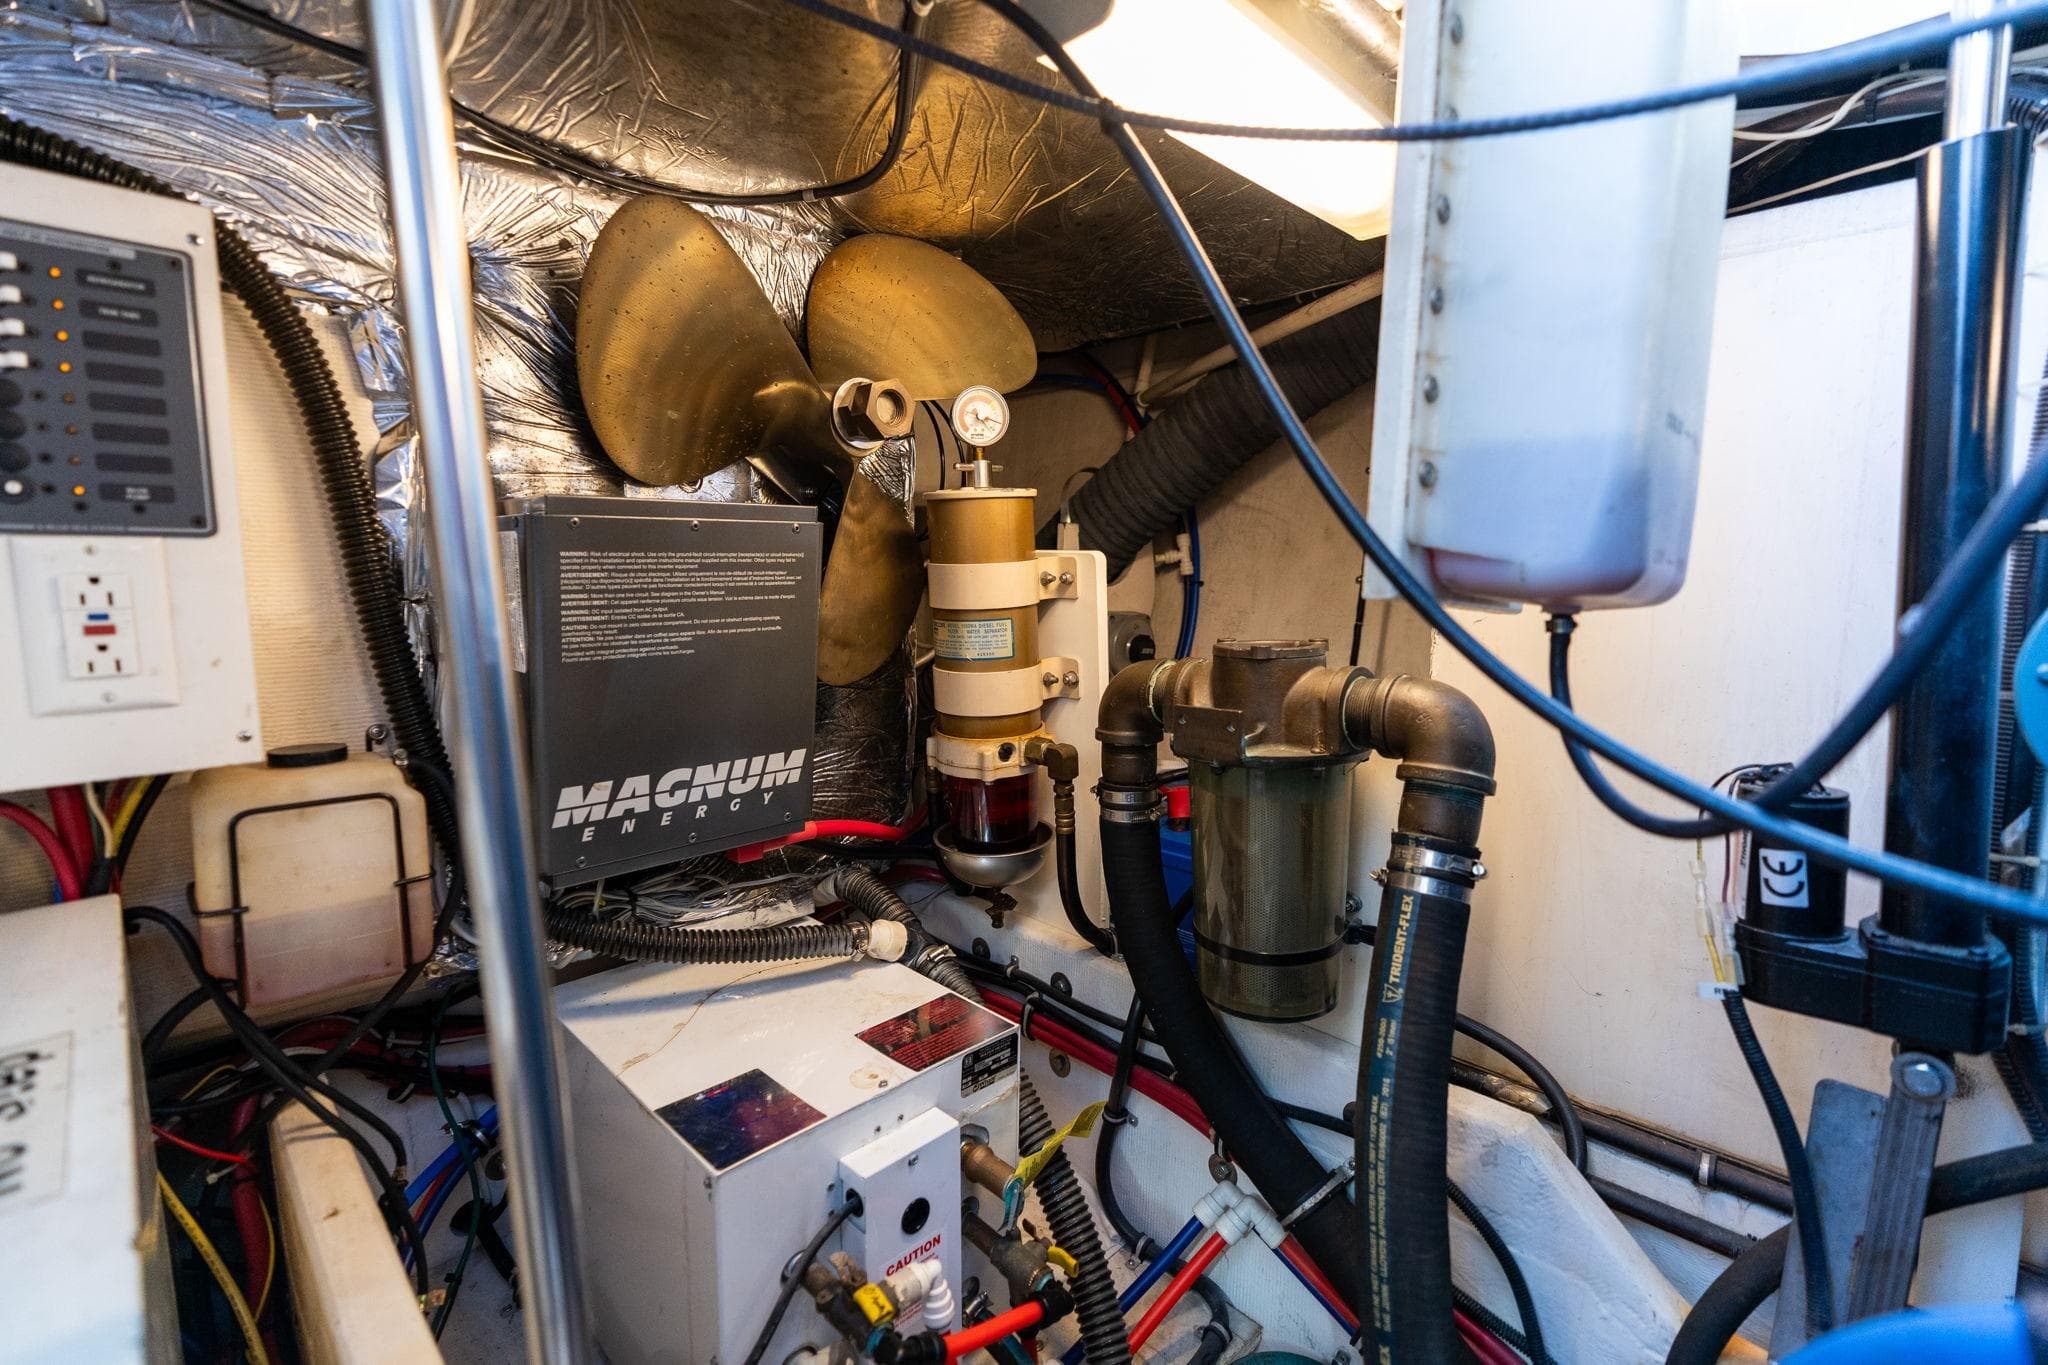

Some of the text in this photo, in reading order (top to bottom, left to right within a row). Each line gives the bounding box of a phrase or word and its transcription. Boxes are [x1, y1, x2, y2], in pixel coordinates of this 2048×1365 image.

[552, 748, 808, 829] MAGNUM
[581, 791, 773, 842] ENERGY
[1388, 894, 1414, 984] TRIDENT-FLEX
[886, 1234, 941, 1277] CAUTION
